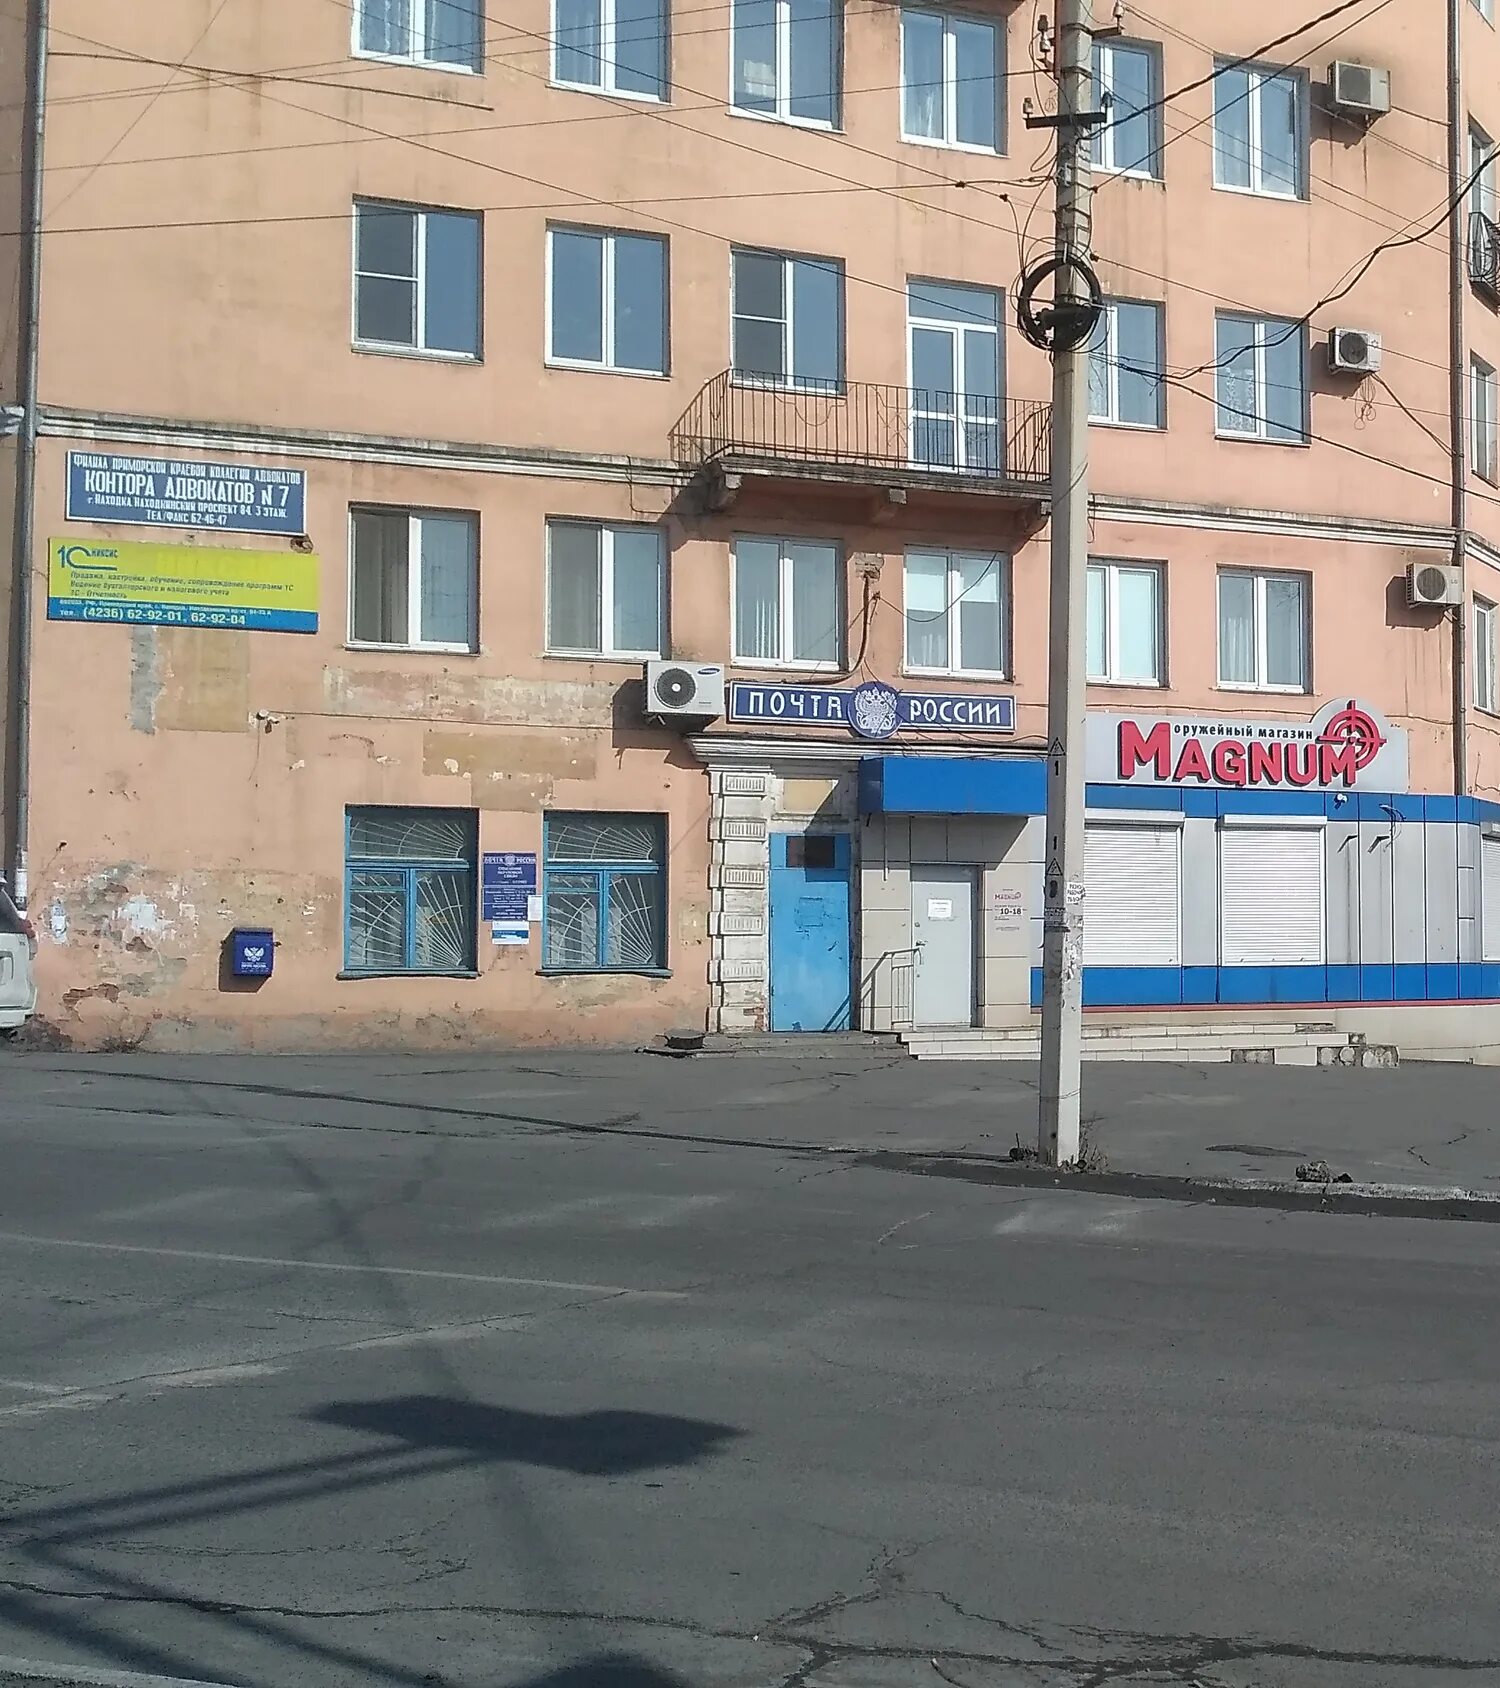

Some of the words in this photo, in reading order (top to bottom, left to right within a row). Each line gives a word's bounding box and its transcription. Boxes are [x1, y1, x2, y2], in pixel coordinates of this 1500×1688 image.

[73, 454, 108, 469] ФИЛИАЛ
[112, 458, 166, 474] ПРИМОРСКОЙ
[170, 463, 206, 477] КРАЕВОЙ
[210, 466, 250, 481] КОЛЛЕГИИ
[255, 469, 301, 485] АДВОКАТОВ
[85, 470, 155, 497] КОНТОРА
[164, 477, 255, 504] АДВОКАТОВ
[279, 485, 290, 507] 7
[198, 502, 238, 515] ПРОСПЕКТ
[83, 606, 124, 621] (4236)
[191, 612, 246, 625] 62-92-04
[749, 691, 842, 719] ПОЧТА
[910, 698, 1001, 724] РОССИИ
[1173, 723, 1254, 738] оружейный
[1258, 729, 1313, 741] магазин
[1117, 720, 1356, 787] MAGNUM
